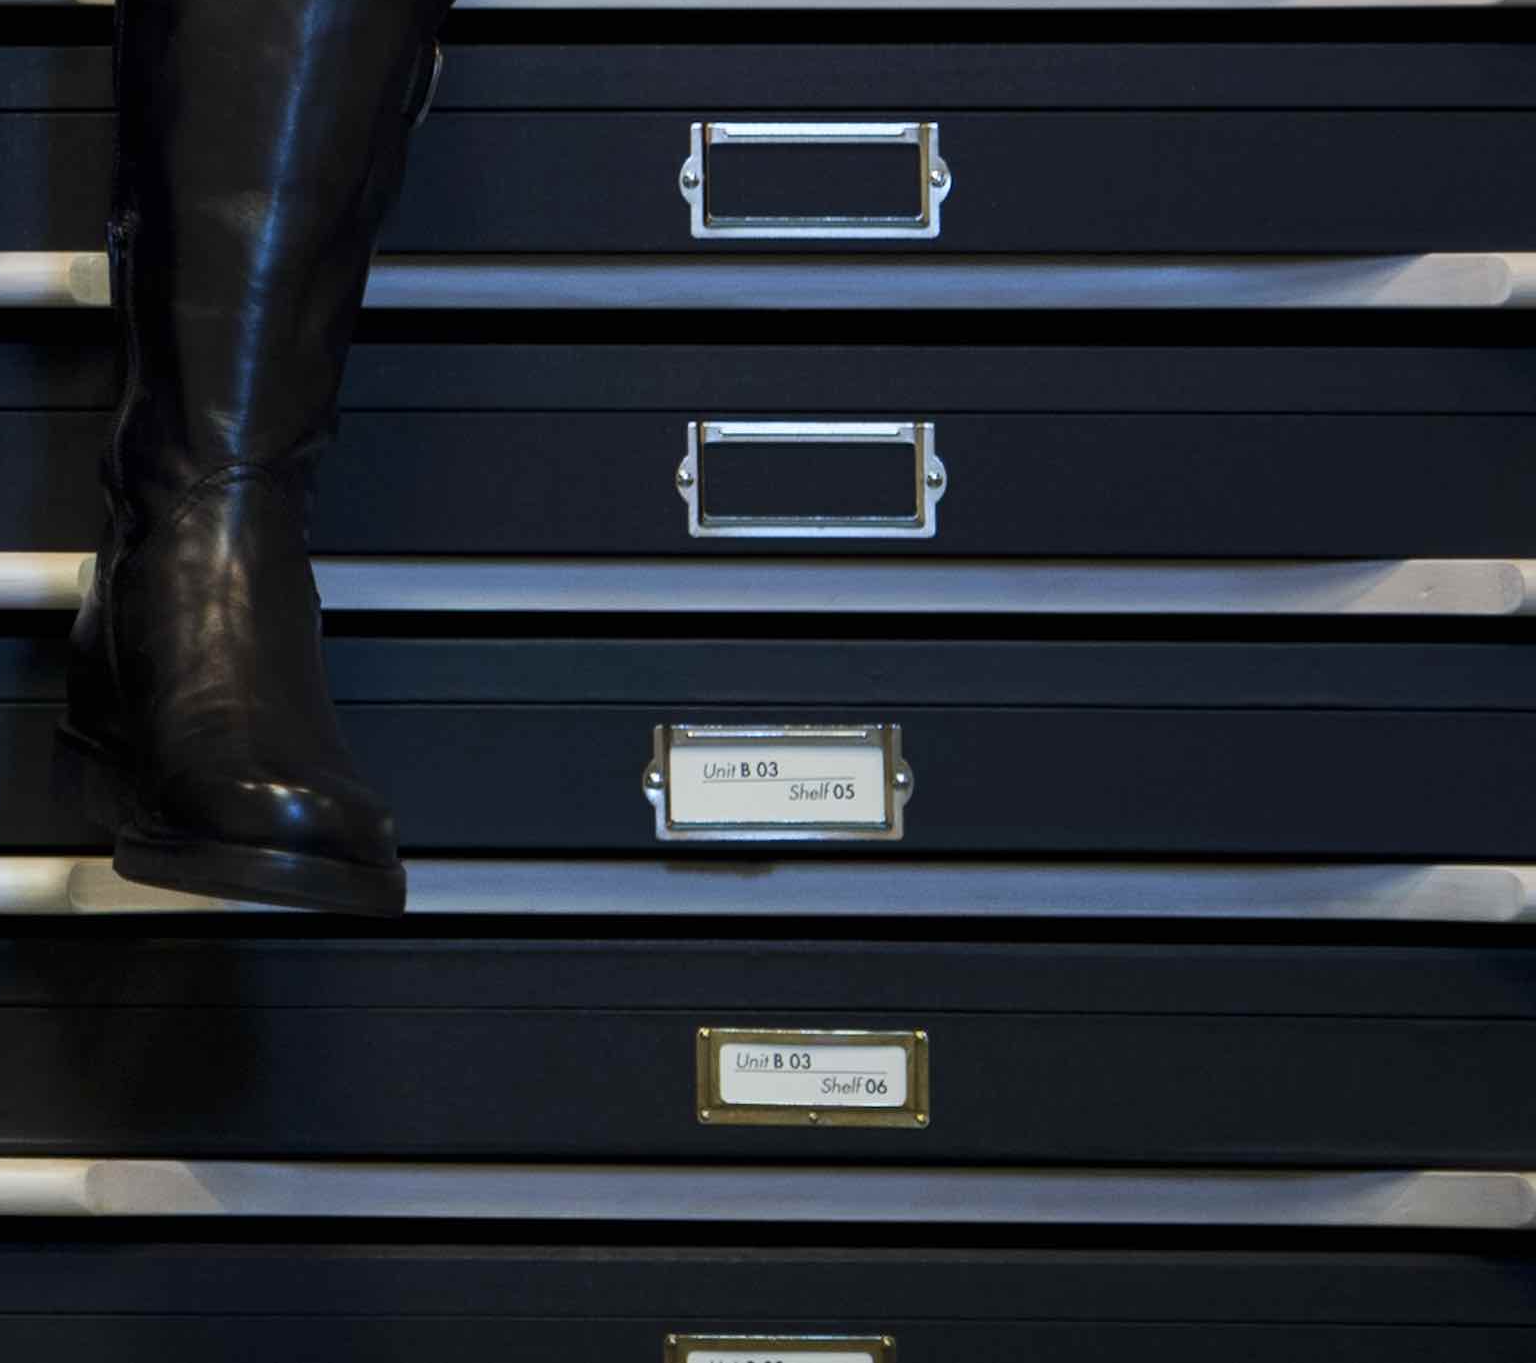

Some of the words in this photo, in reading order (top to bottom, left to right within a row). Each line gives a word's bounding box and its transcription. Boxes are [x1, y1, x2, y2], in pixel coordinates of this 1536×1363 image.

[703, 763, 736, 779] Unit
[741, 762, 751, 777] B
[757, 762, 778, 777] 03
[789, 782, 830, 801] Shelf
[833, 784, 855, 800] 05
[736, 1052, 769, 1069] Unit
[773, 1053, 784, 1068] B
[789, 1053, 811, 1069] 03
[820, 1077, 862, 1095] Shelf
[865, 1078, 887, 1094] 06
